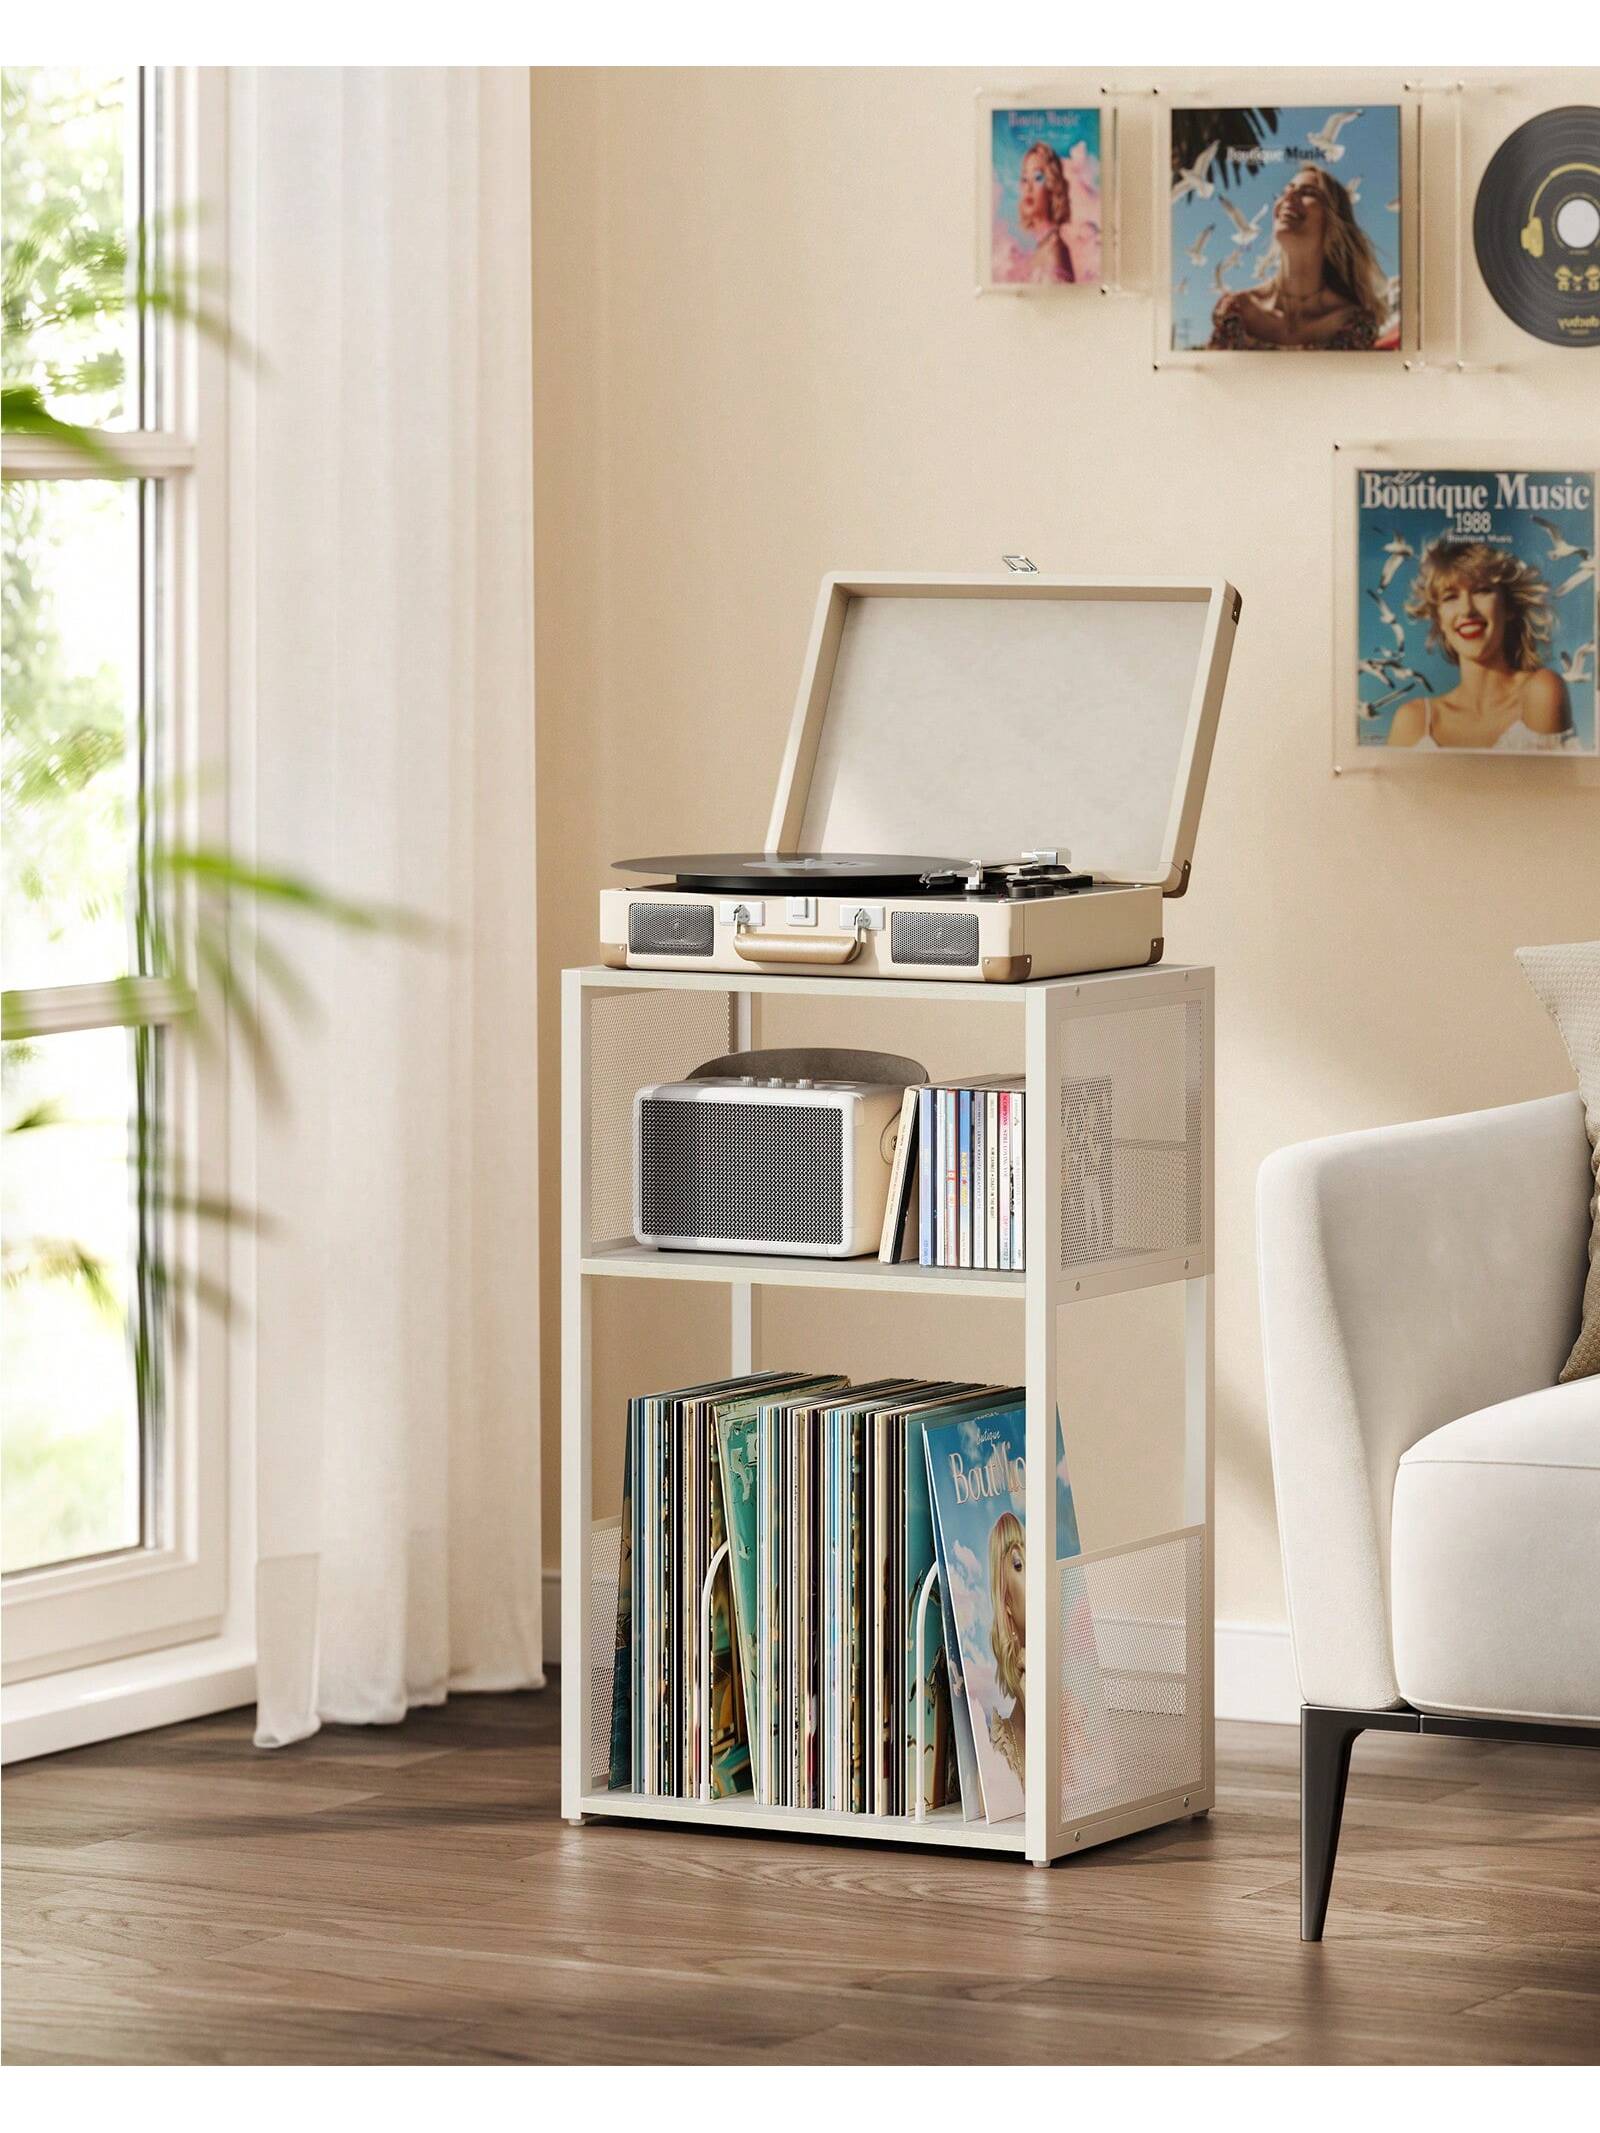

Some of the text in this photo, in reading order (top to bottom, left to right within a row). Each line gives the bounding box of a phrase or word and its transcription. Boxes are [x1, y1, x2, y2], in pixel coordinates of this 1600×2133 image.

[1362, 472, 1590, 518] Boutique Music
[1455, 511, 1492, 533] 1988
